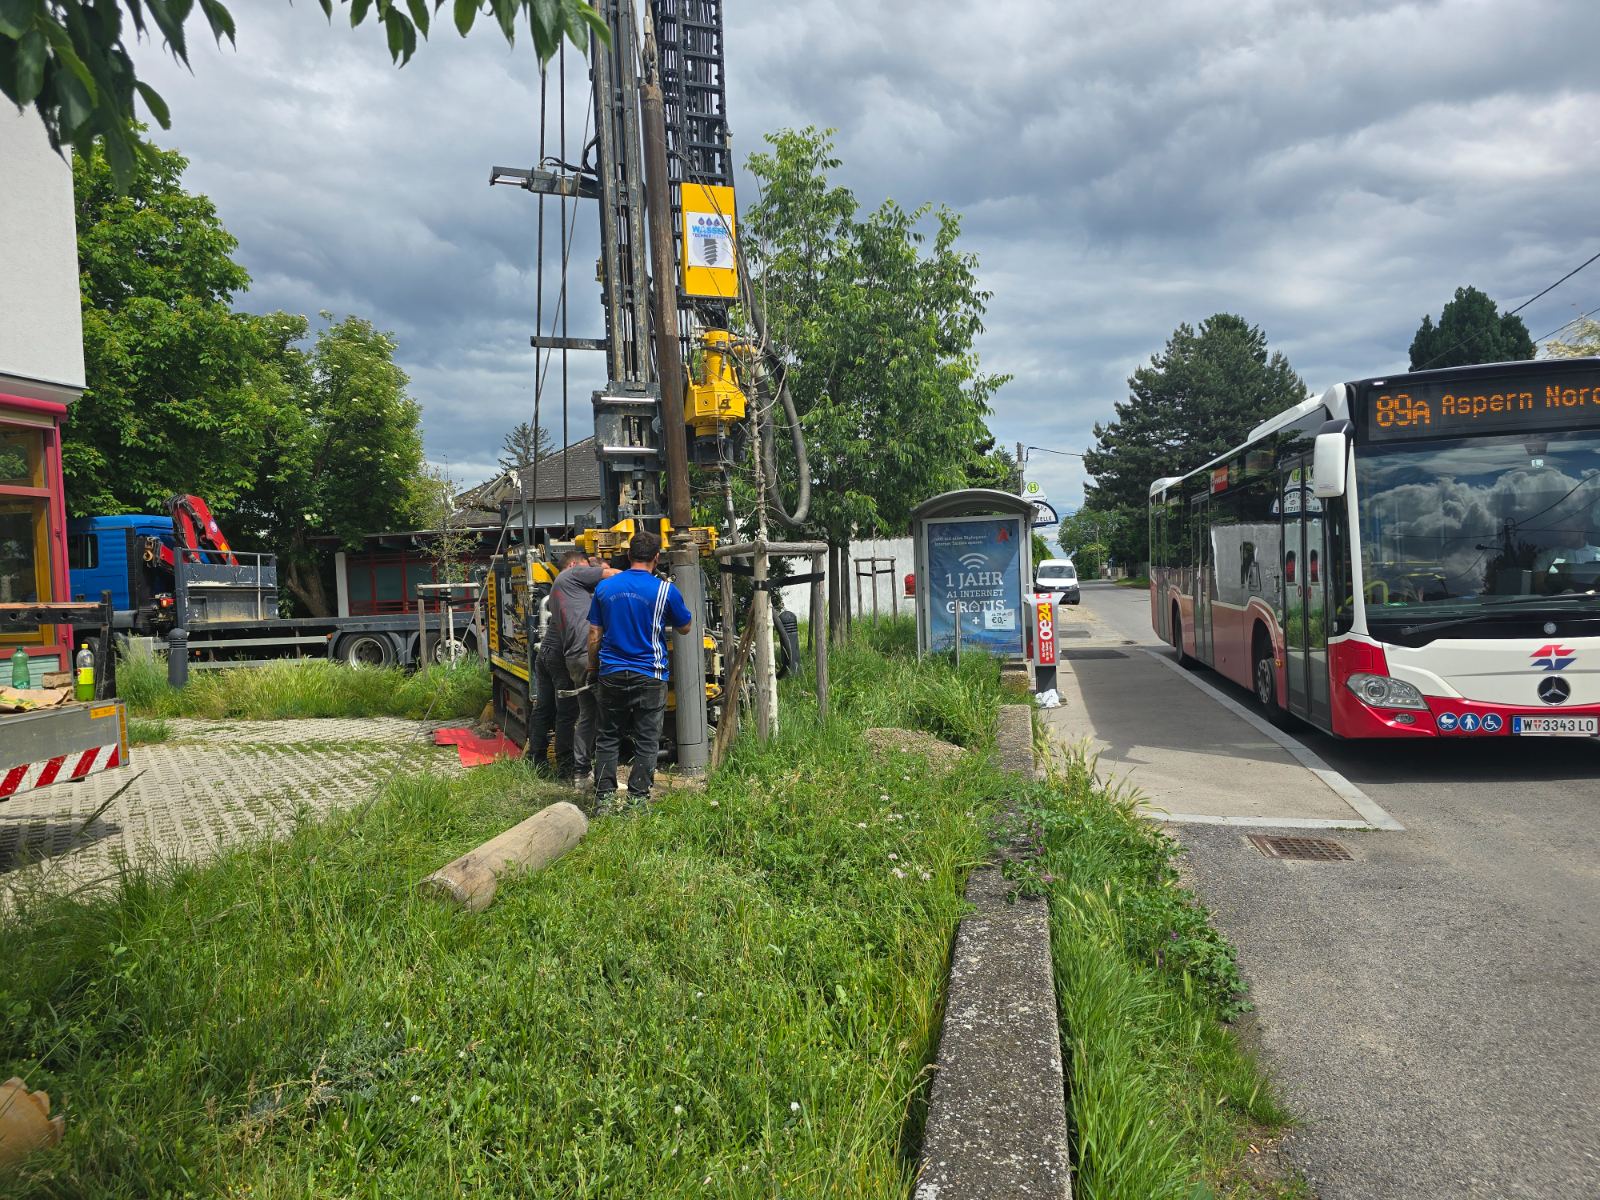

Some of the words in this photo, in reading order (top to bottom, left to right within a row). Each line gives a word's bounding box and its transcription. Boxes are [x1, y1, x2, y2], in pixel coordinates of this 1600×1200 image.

[1376, 394, 1431, 427] 89A
[1442, 392, 1533, 417] Aspern
[945, 573, 955, 587] 1
[958, 571, 1004, 589] JAHR
[960, 589, 1004, 598] INTERNET
[1523, 719, 1533, 731] W
[1543, 719, 1576, 732] 3343
